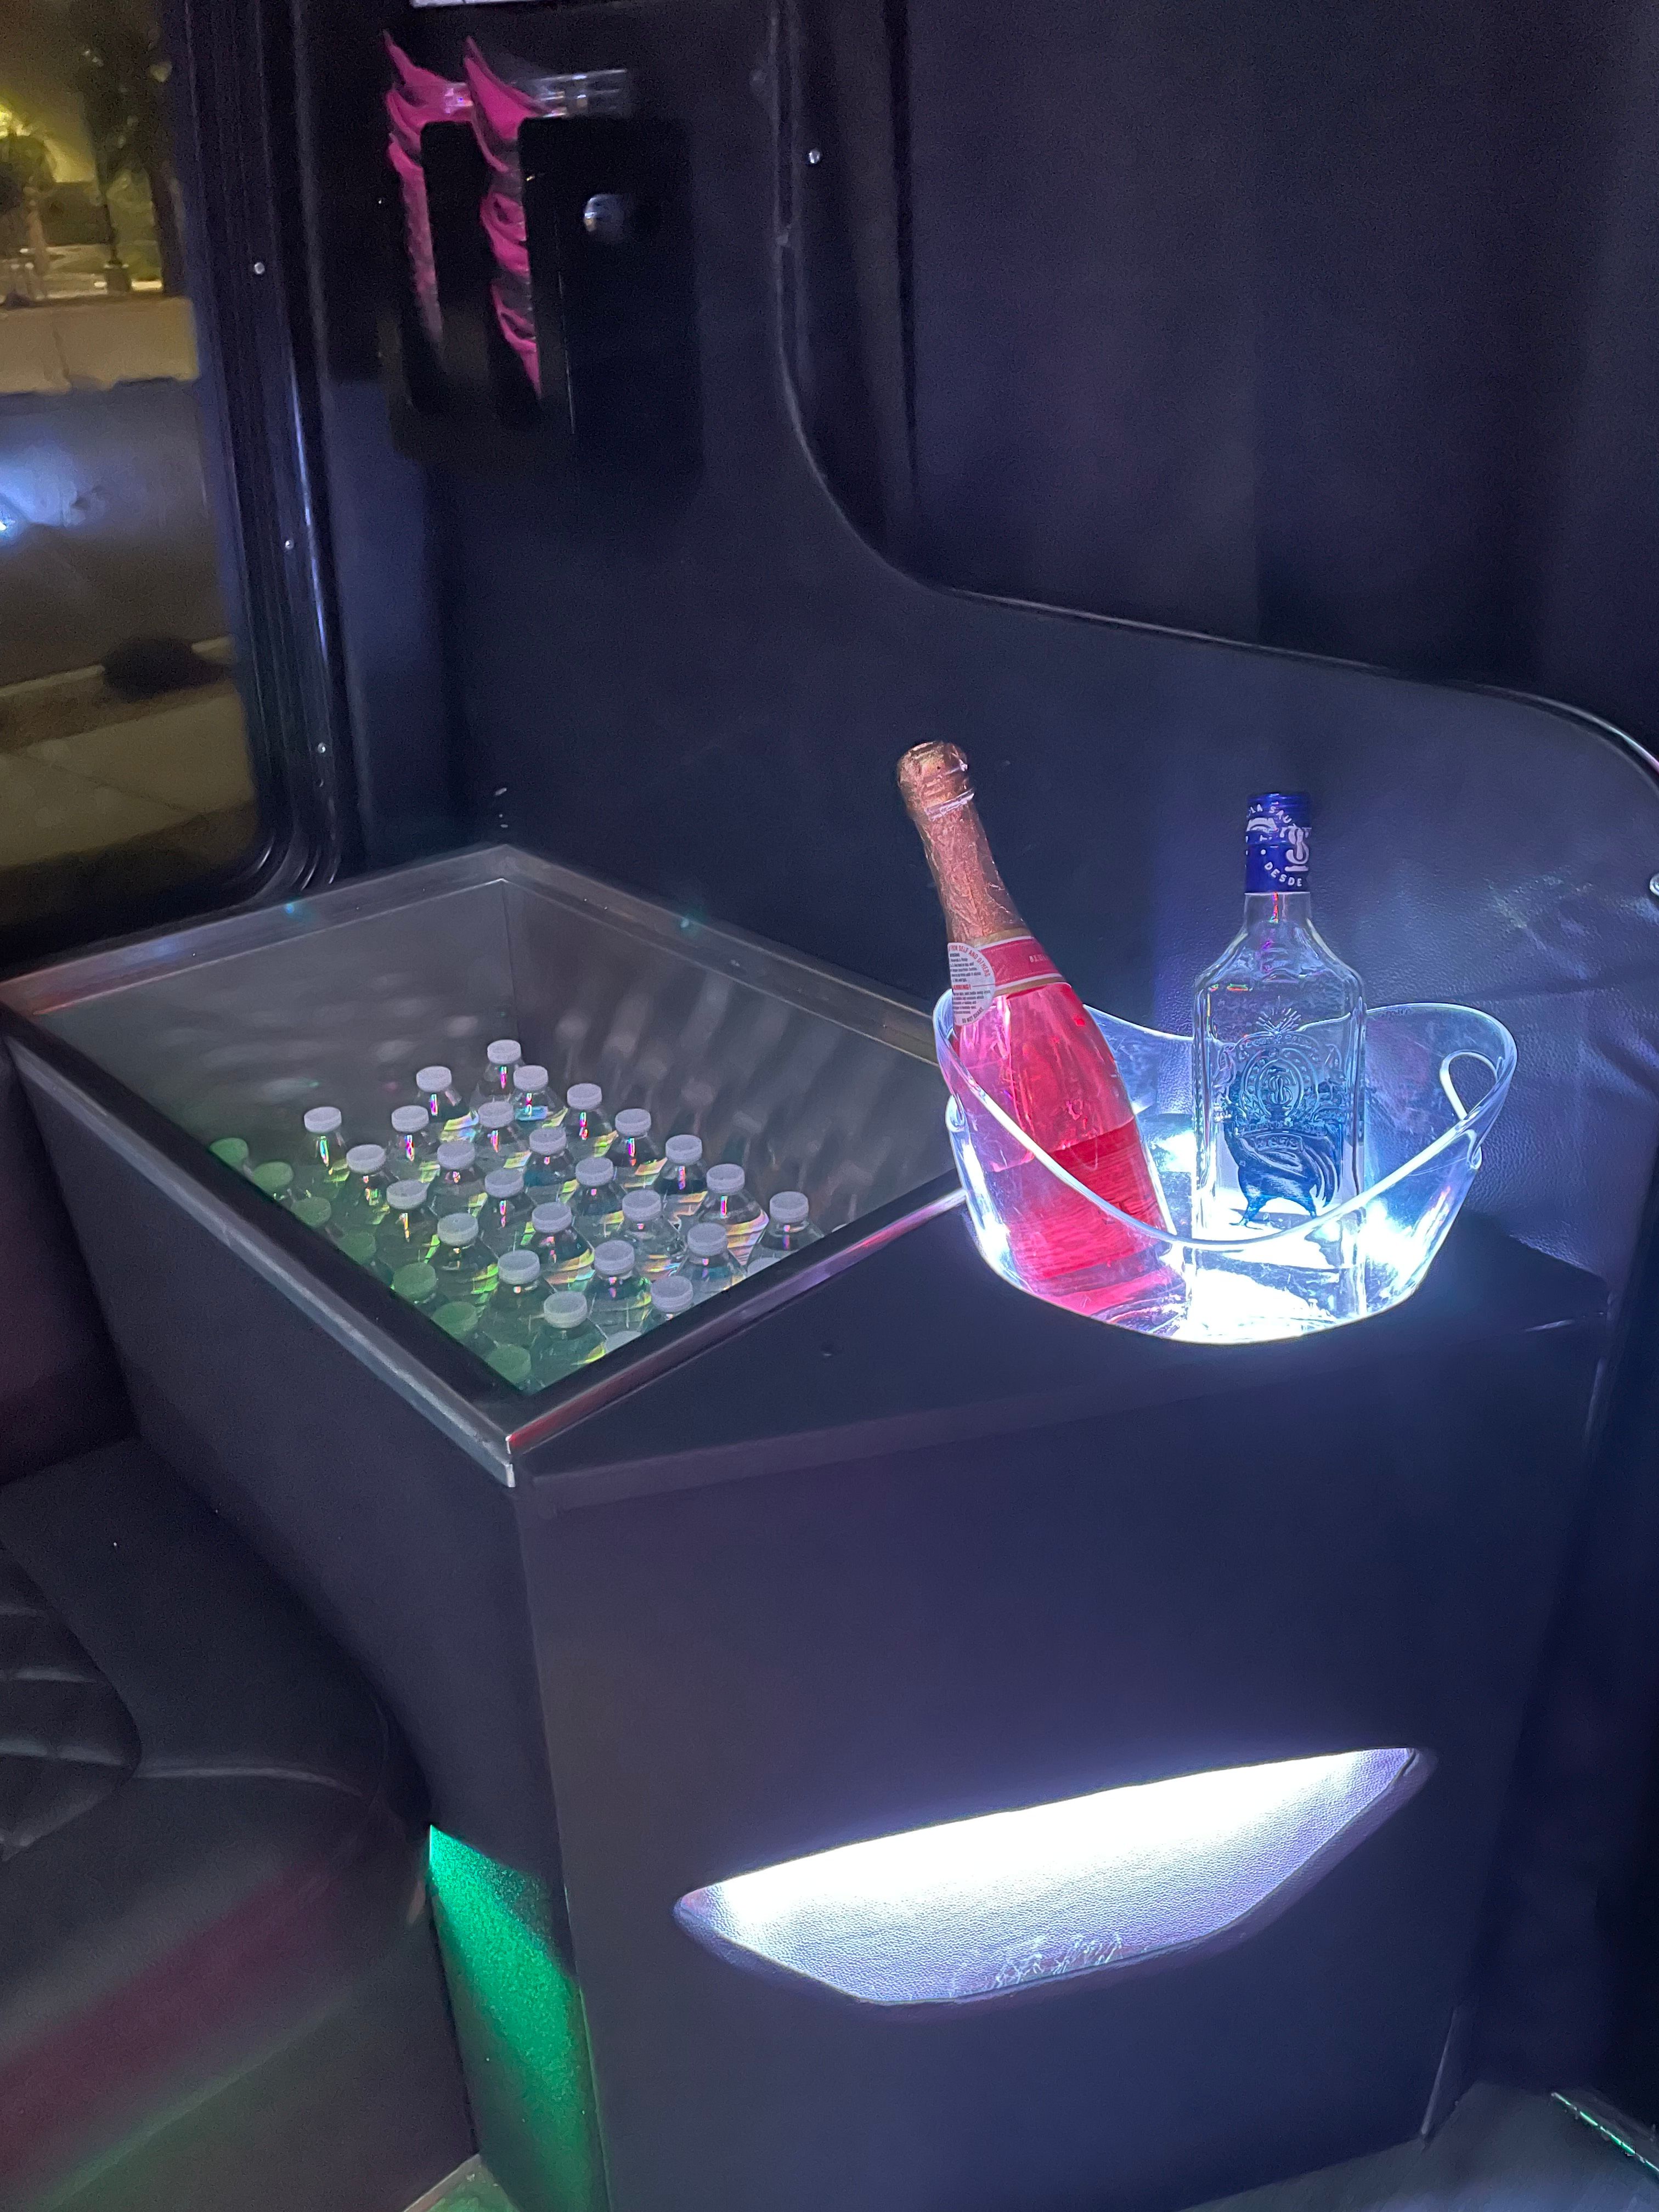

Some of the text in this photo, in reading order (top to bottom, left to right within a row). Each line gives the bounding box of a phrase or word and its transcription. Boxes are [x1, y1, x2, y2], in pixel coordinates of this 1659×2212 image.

[1264, 862, 1302, 887] DESDE
[968, 950, 979, 960] AND
[977, 957, 991, 977] OTHERS
